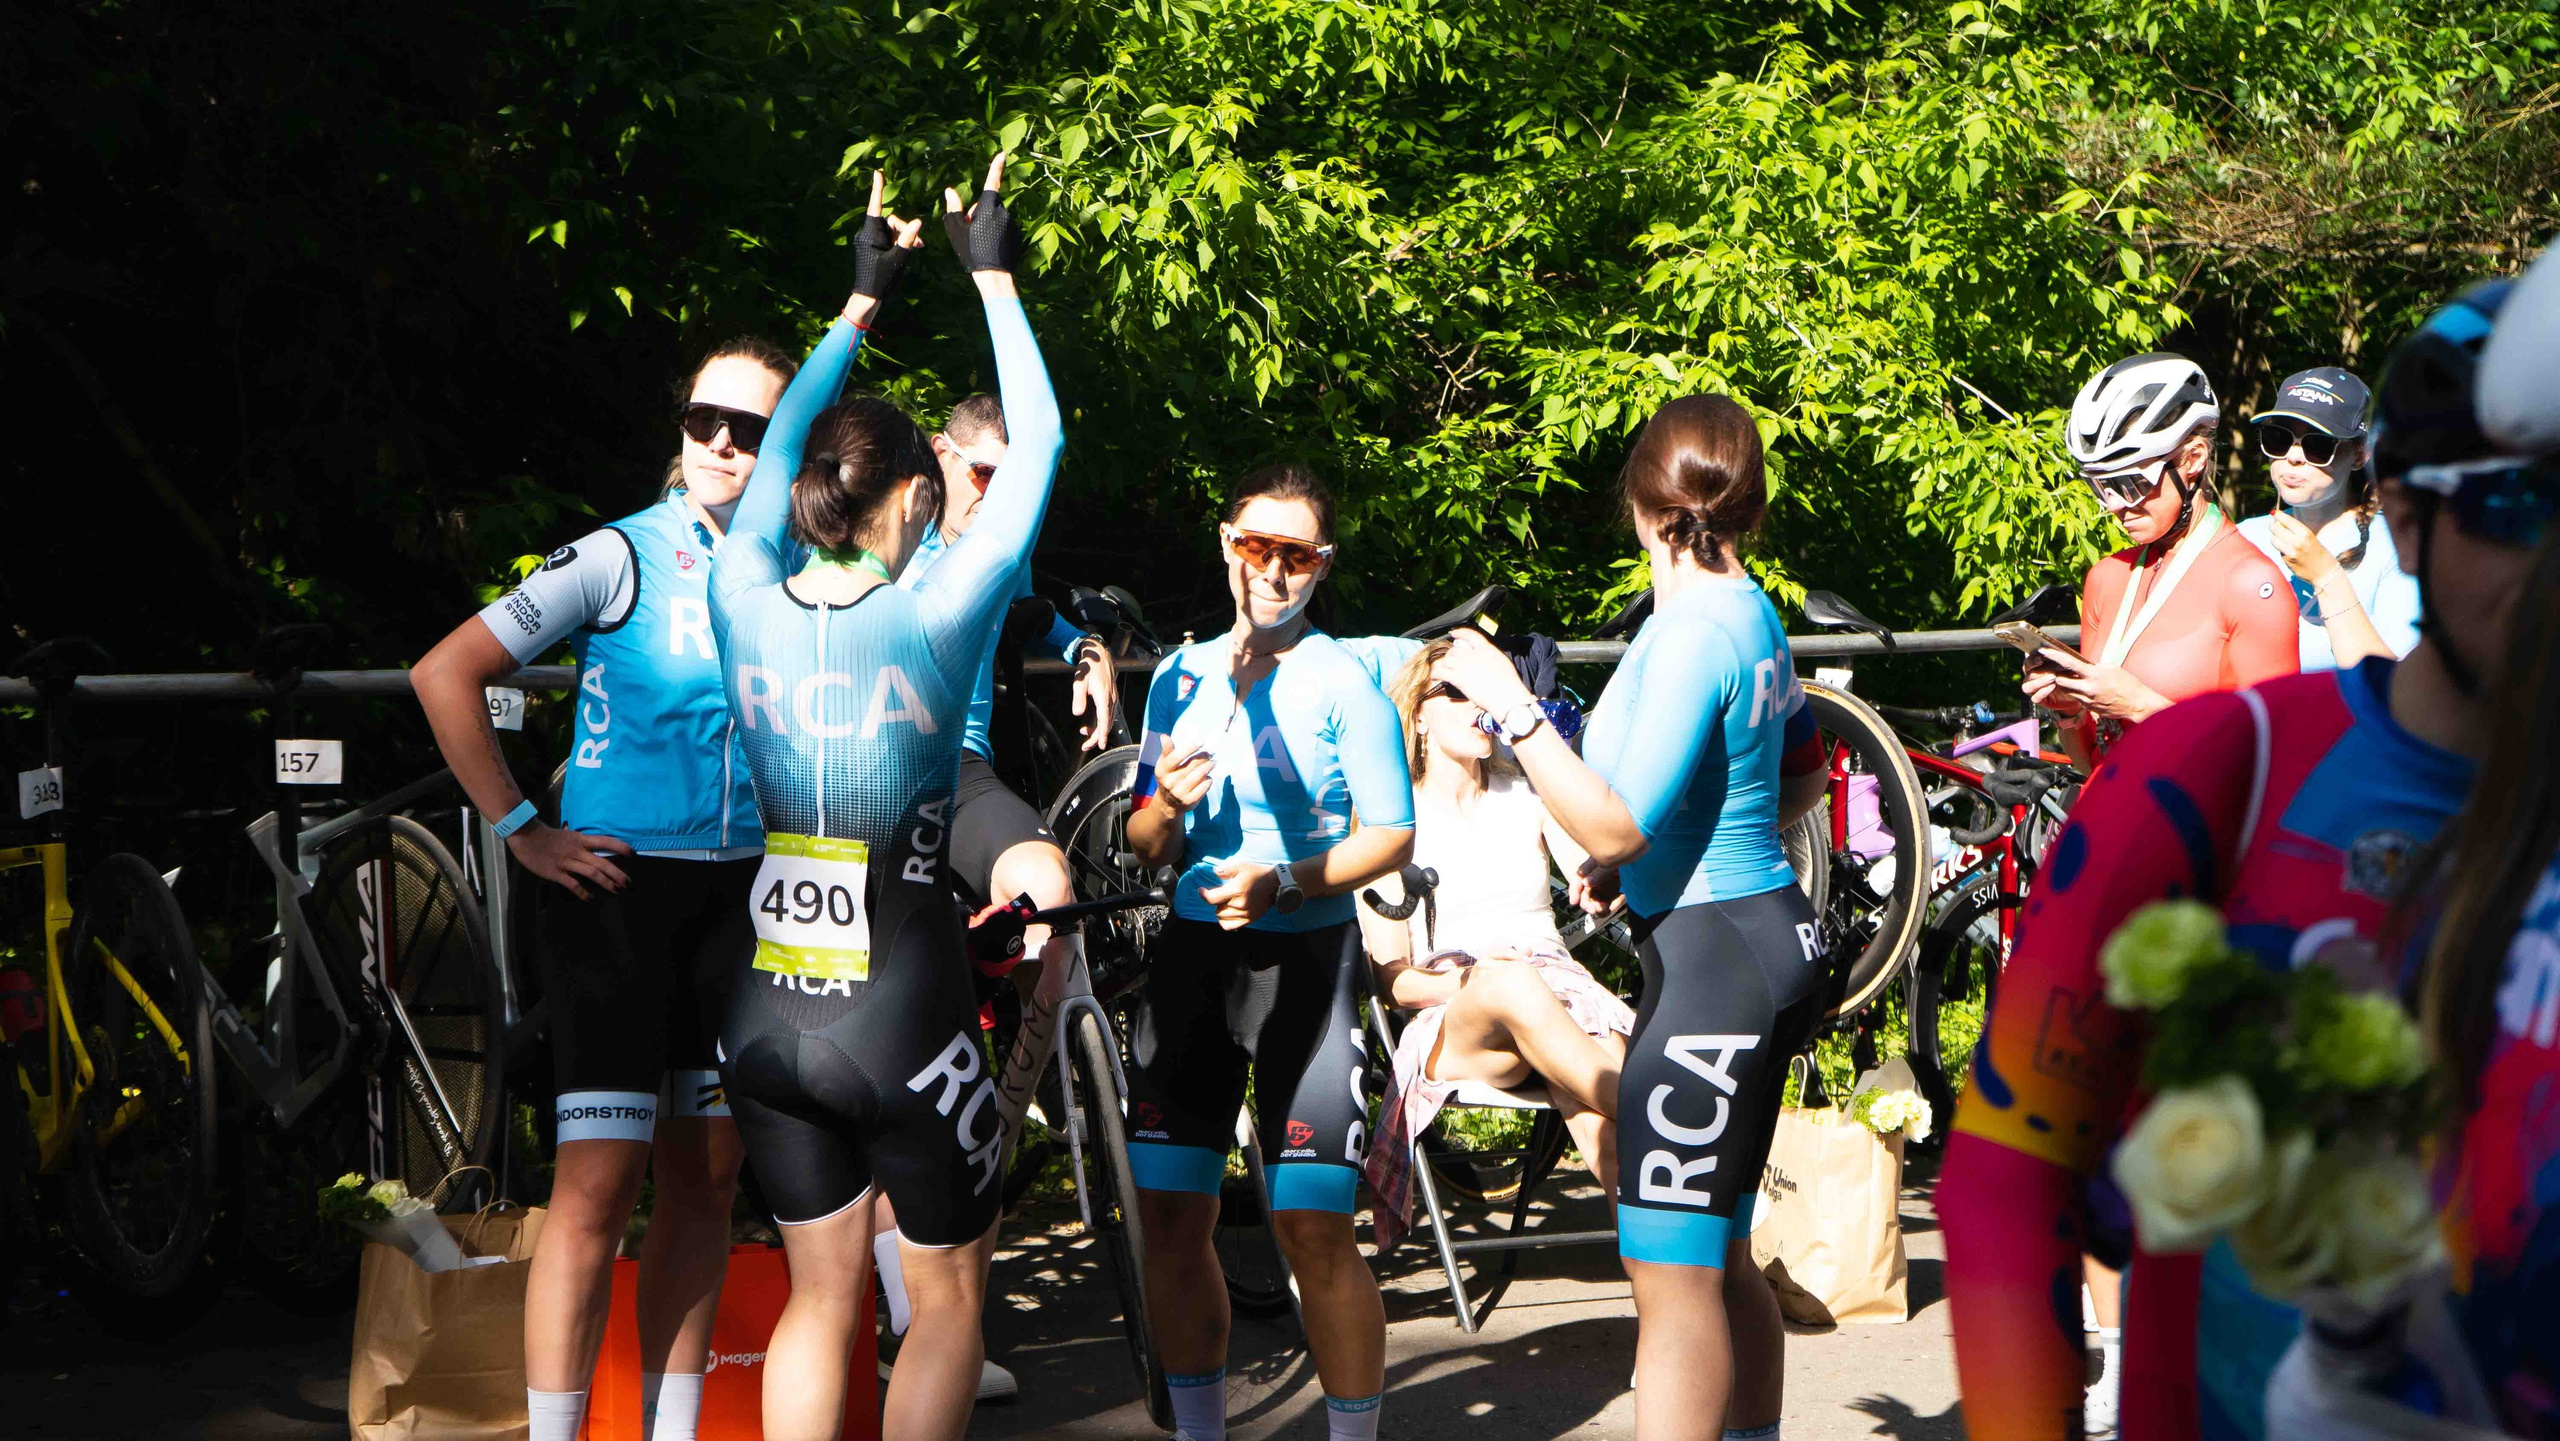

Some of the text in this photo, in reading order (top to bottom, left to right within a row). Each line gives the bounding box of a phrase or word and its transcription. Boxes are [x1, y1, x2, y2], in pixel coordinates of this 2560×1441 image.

[2287, 388, 2334, 406] ASTANA
[504, 602, 536, 637] STROY
[511, 596, 541, 632] INDOR
[517, 590, 543, 619] KRAS
[576, 662, 609, 768] RCA
[737, 664, 938, 739] RCA
[280, 752, 319, 773] 157
[902, 796, 951, 885] RCA
[760, 879, 856, 927] 490
[1795, 917, 1831, 962] RC
[907, 1029, 1003, 1197] RCA
[1638, 1034, 1761, 1208] RCA
[1135, 1132, 1170, 1140] bergamo
[1773, 1167, 1798, 1194] Union
